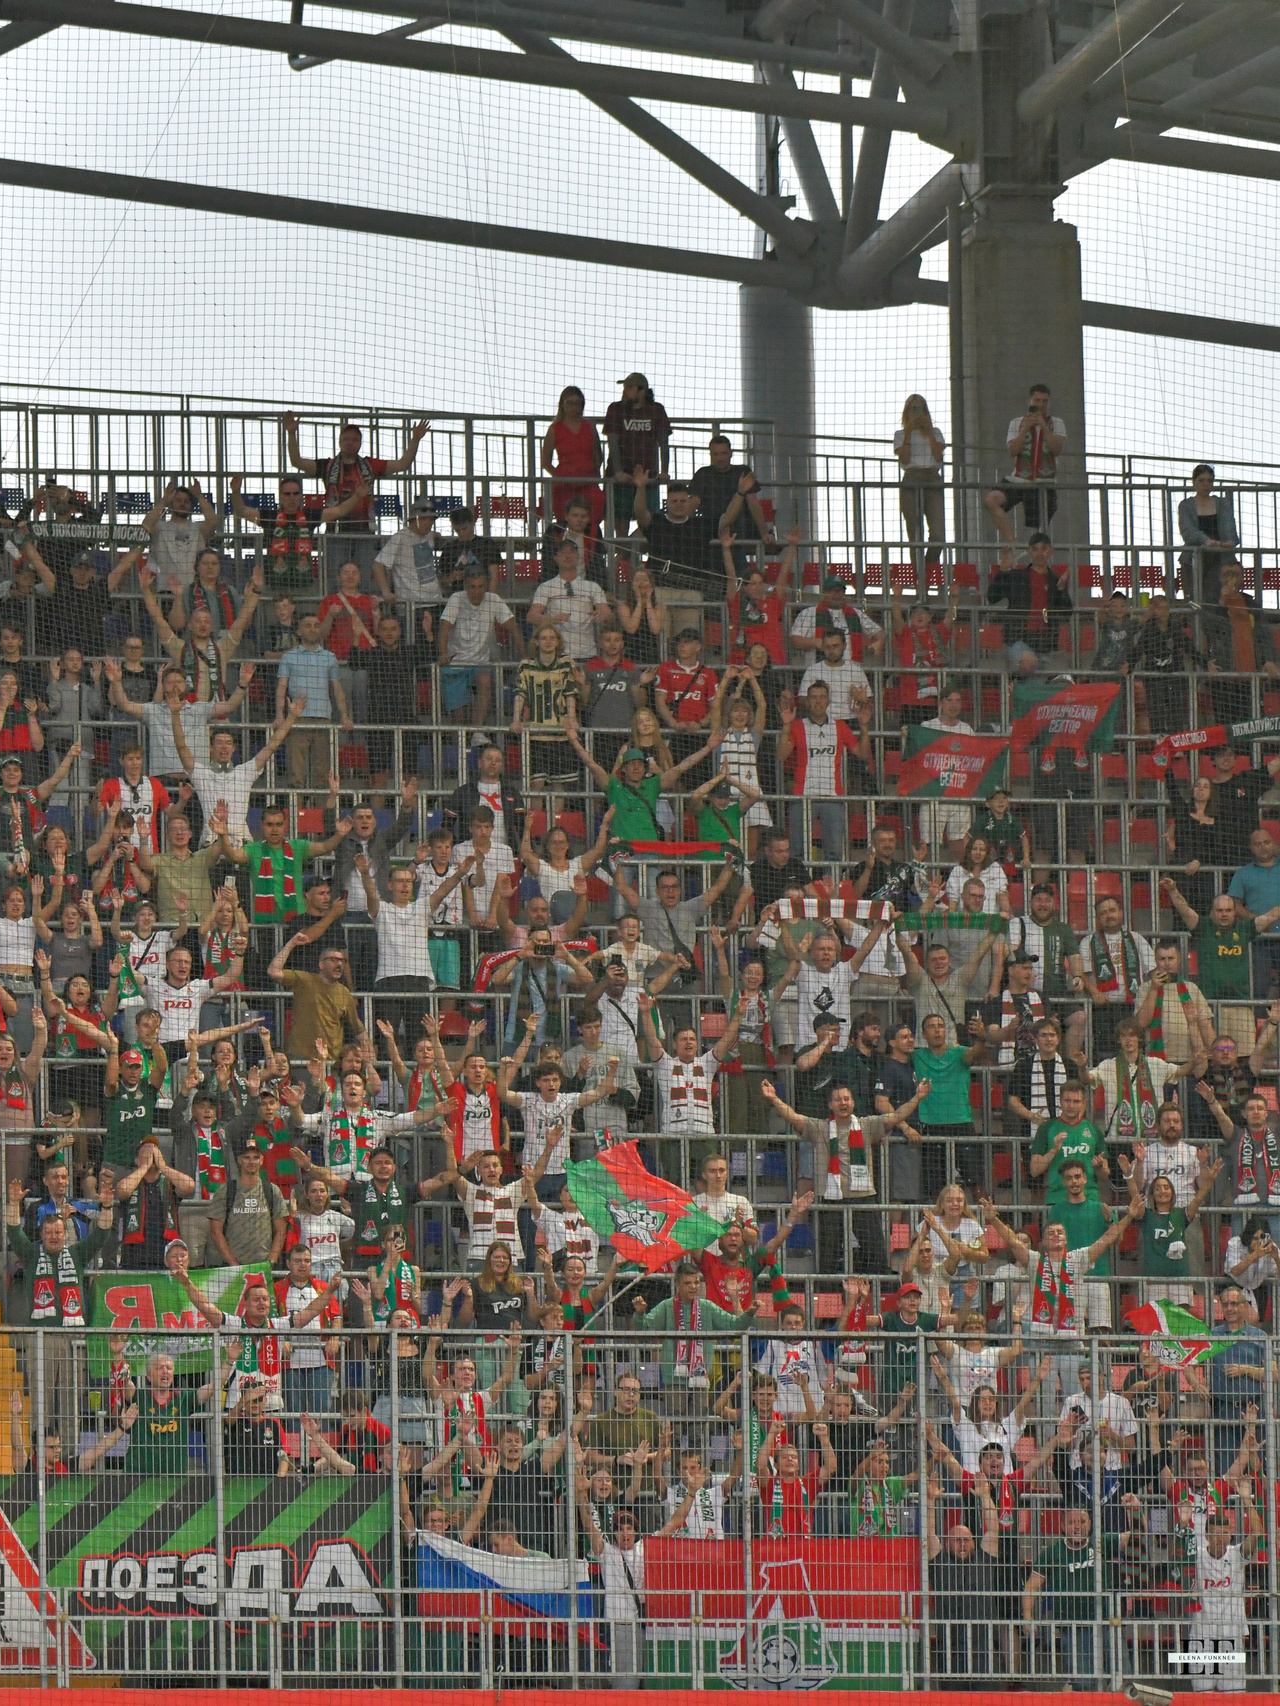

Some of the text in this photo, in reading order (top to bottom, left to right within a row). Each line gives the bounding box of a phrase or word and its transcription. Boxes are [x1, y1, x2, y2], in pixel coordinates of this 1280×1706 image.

[623, 419, 652, 431] VANS
[32, 524, 151, 542] ФК ЛОКОМОТИВ МОСКВА
[1036, 704, 1099, 722] СТУДЕНЧЕСКИЙ
[1048, 718, 1080, 733] СЕКТОР
[1170, 730, 1207, 748] СПАСИБО
[939, 772, 968, 790] СЕКТОР
[105, 1284, 157, 1328] Я
[82, 1542, 385, 1623] ПОЕЗДА
